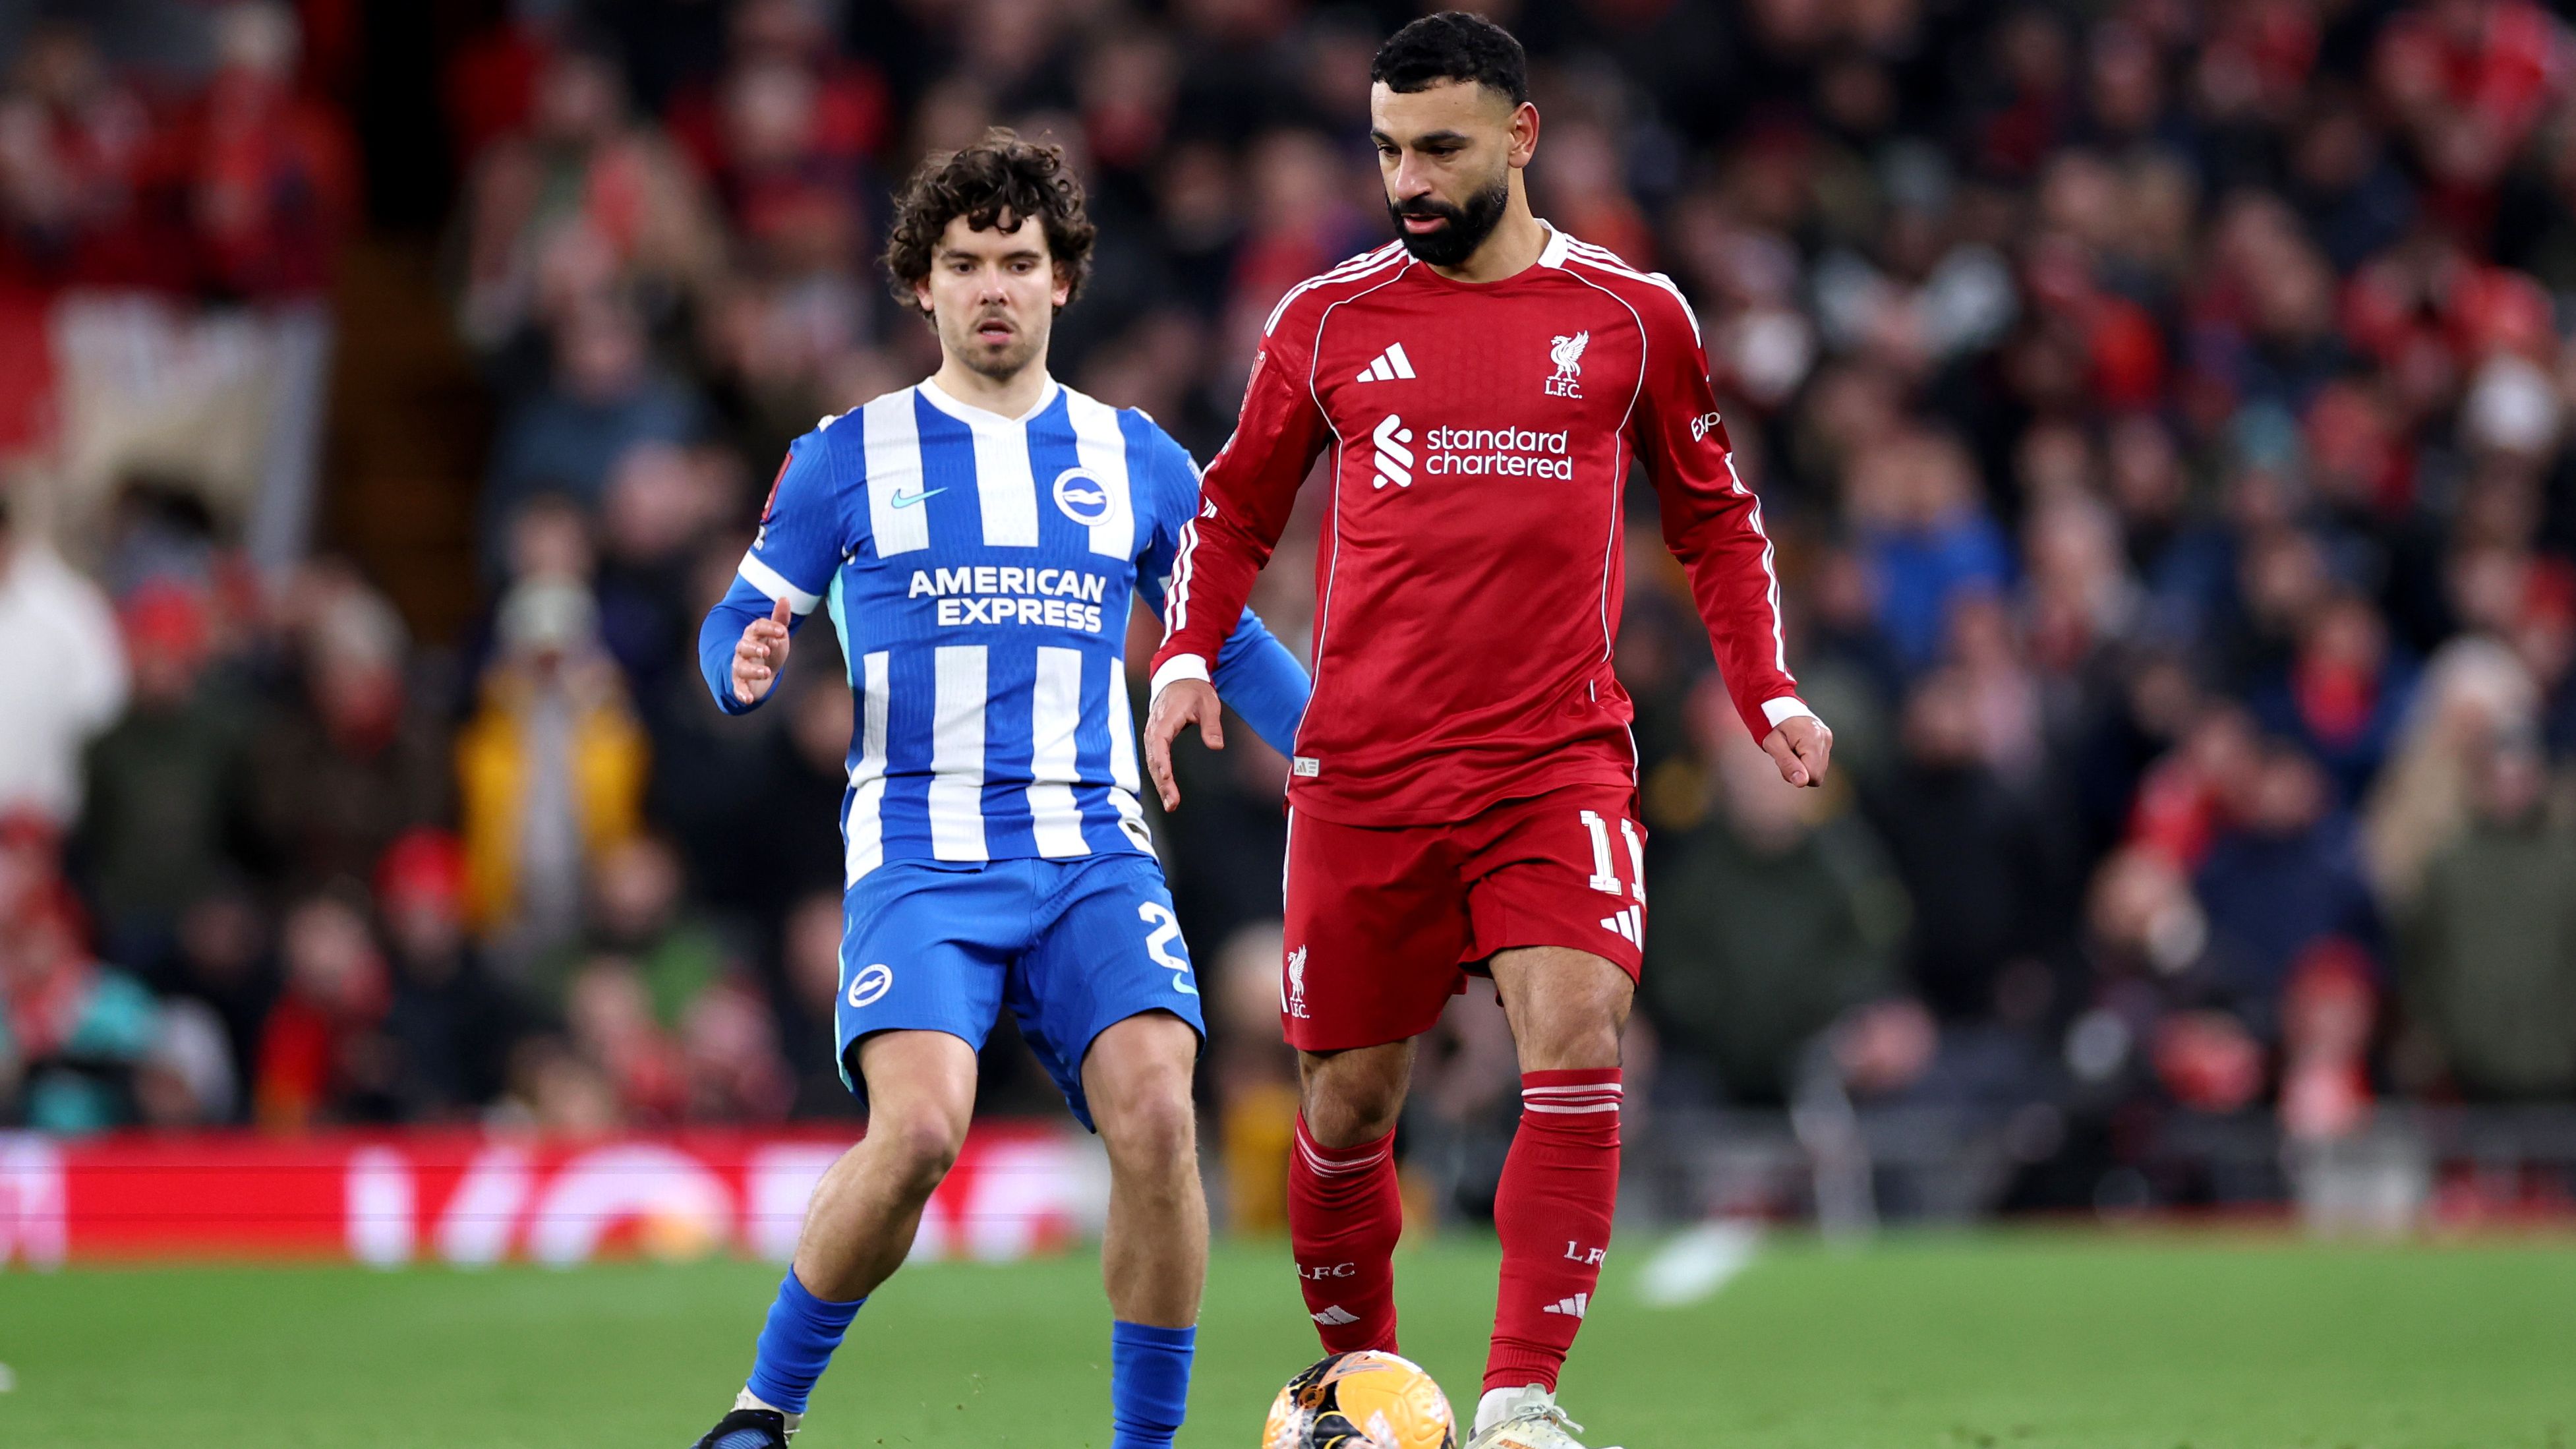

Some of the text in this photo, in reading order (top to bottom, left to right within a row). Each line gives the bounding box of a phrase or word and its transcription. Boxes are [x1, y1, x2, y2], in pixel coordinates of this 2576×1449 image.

[1544, 380, 1583, 399] L.F.C.
[1427, 425, 1567, 454] standard
[1426, 450, 1572, 481] chartered
[908, 566, 1106, 603] AMERICAN
[937, 597, 1102, 634] EXPRESS
[1580, 810, 1647, 910] 11
[1138, 901, 1189, 973] 2
[1296, 1262, 1355, 1280] LFC
